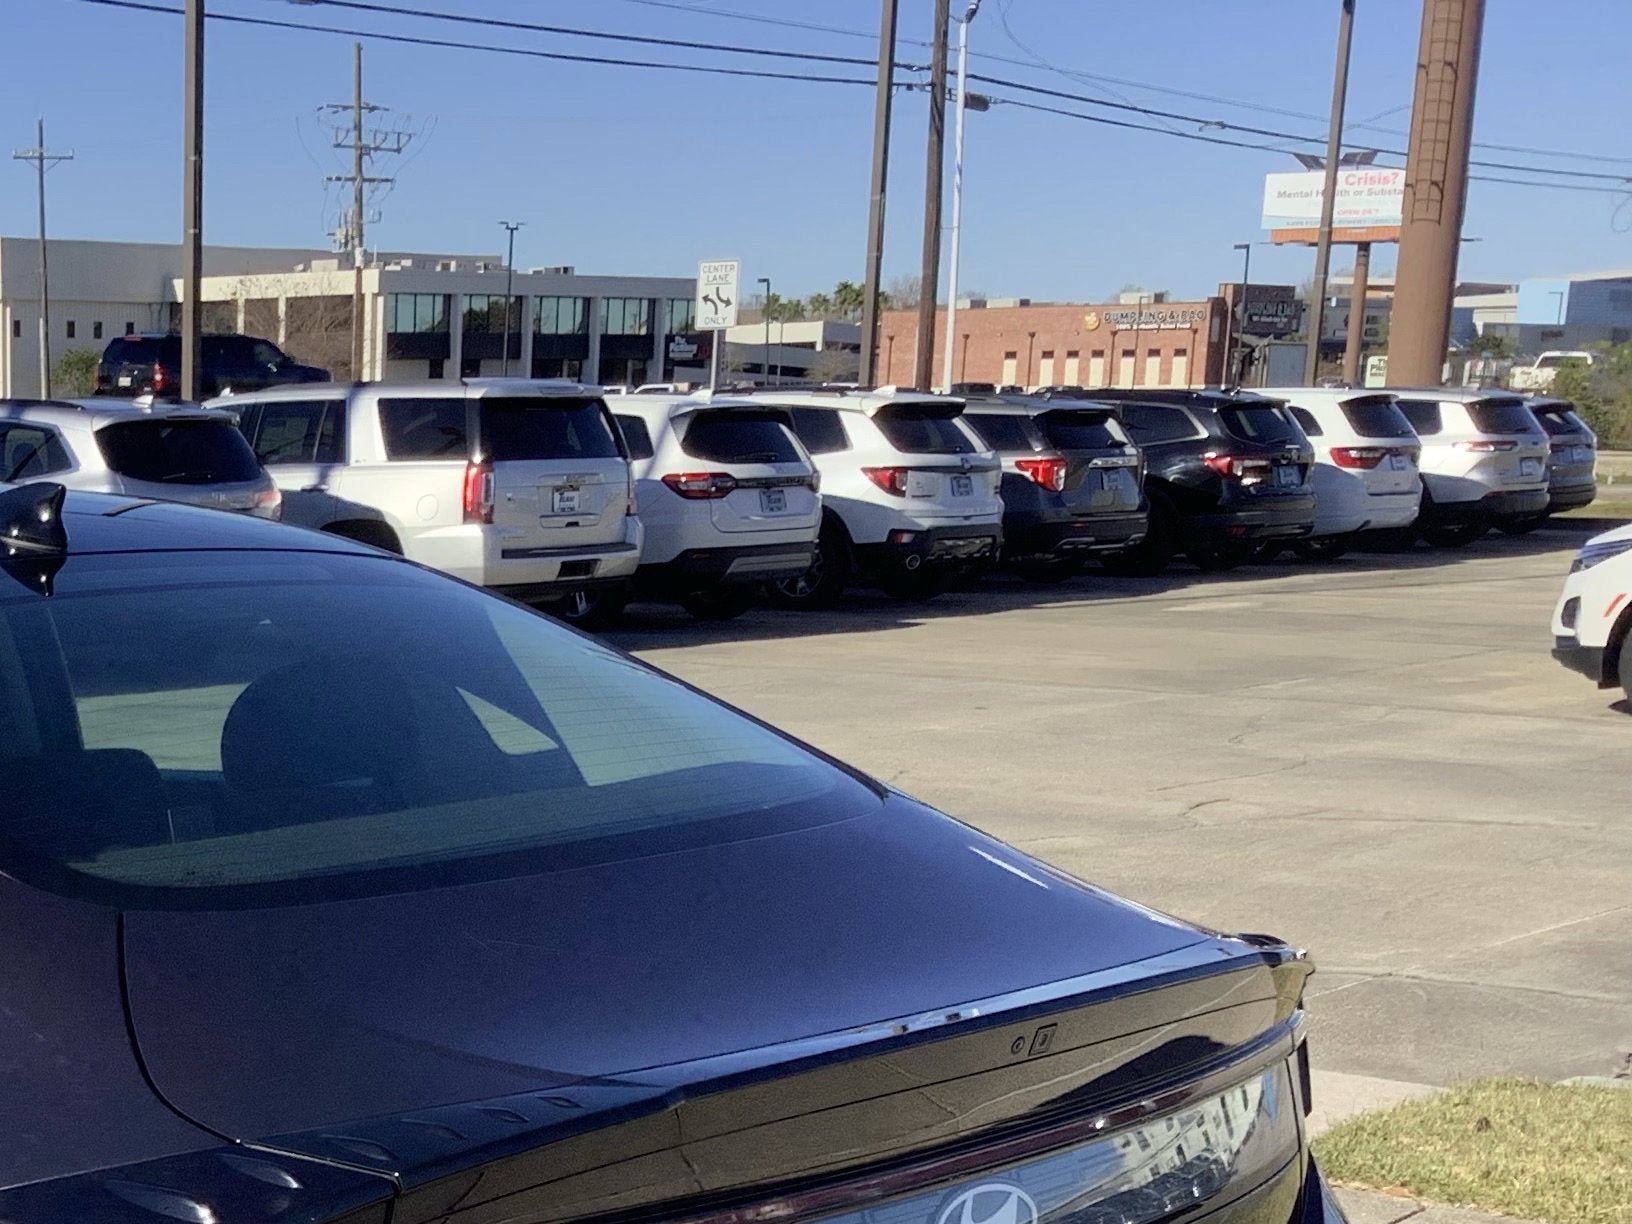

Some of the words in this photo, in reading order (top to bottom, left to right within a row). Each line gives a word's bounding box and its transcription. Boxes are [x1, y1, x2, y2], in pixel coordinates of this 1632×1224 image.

[1344, 172, 1400, 186] Crisis?
[1276, 190, 1313, 199] Mental
[1316, 188, 1350, 198] Hlth
[1353, 189, 1364, 197] or
[702, 264, 735, 273] CENTER
[706, 273, 730, 283] LANE
[704, 316, 728, 325] ONLY
